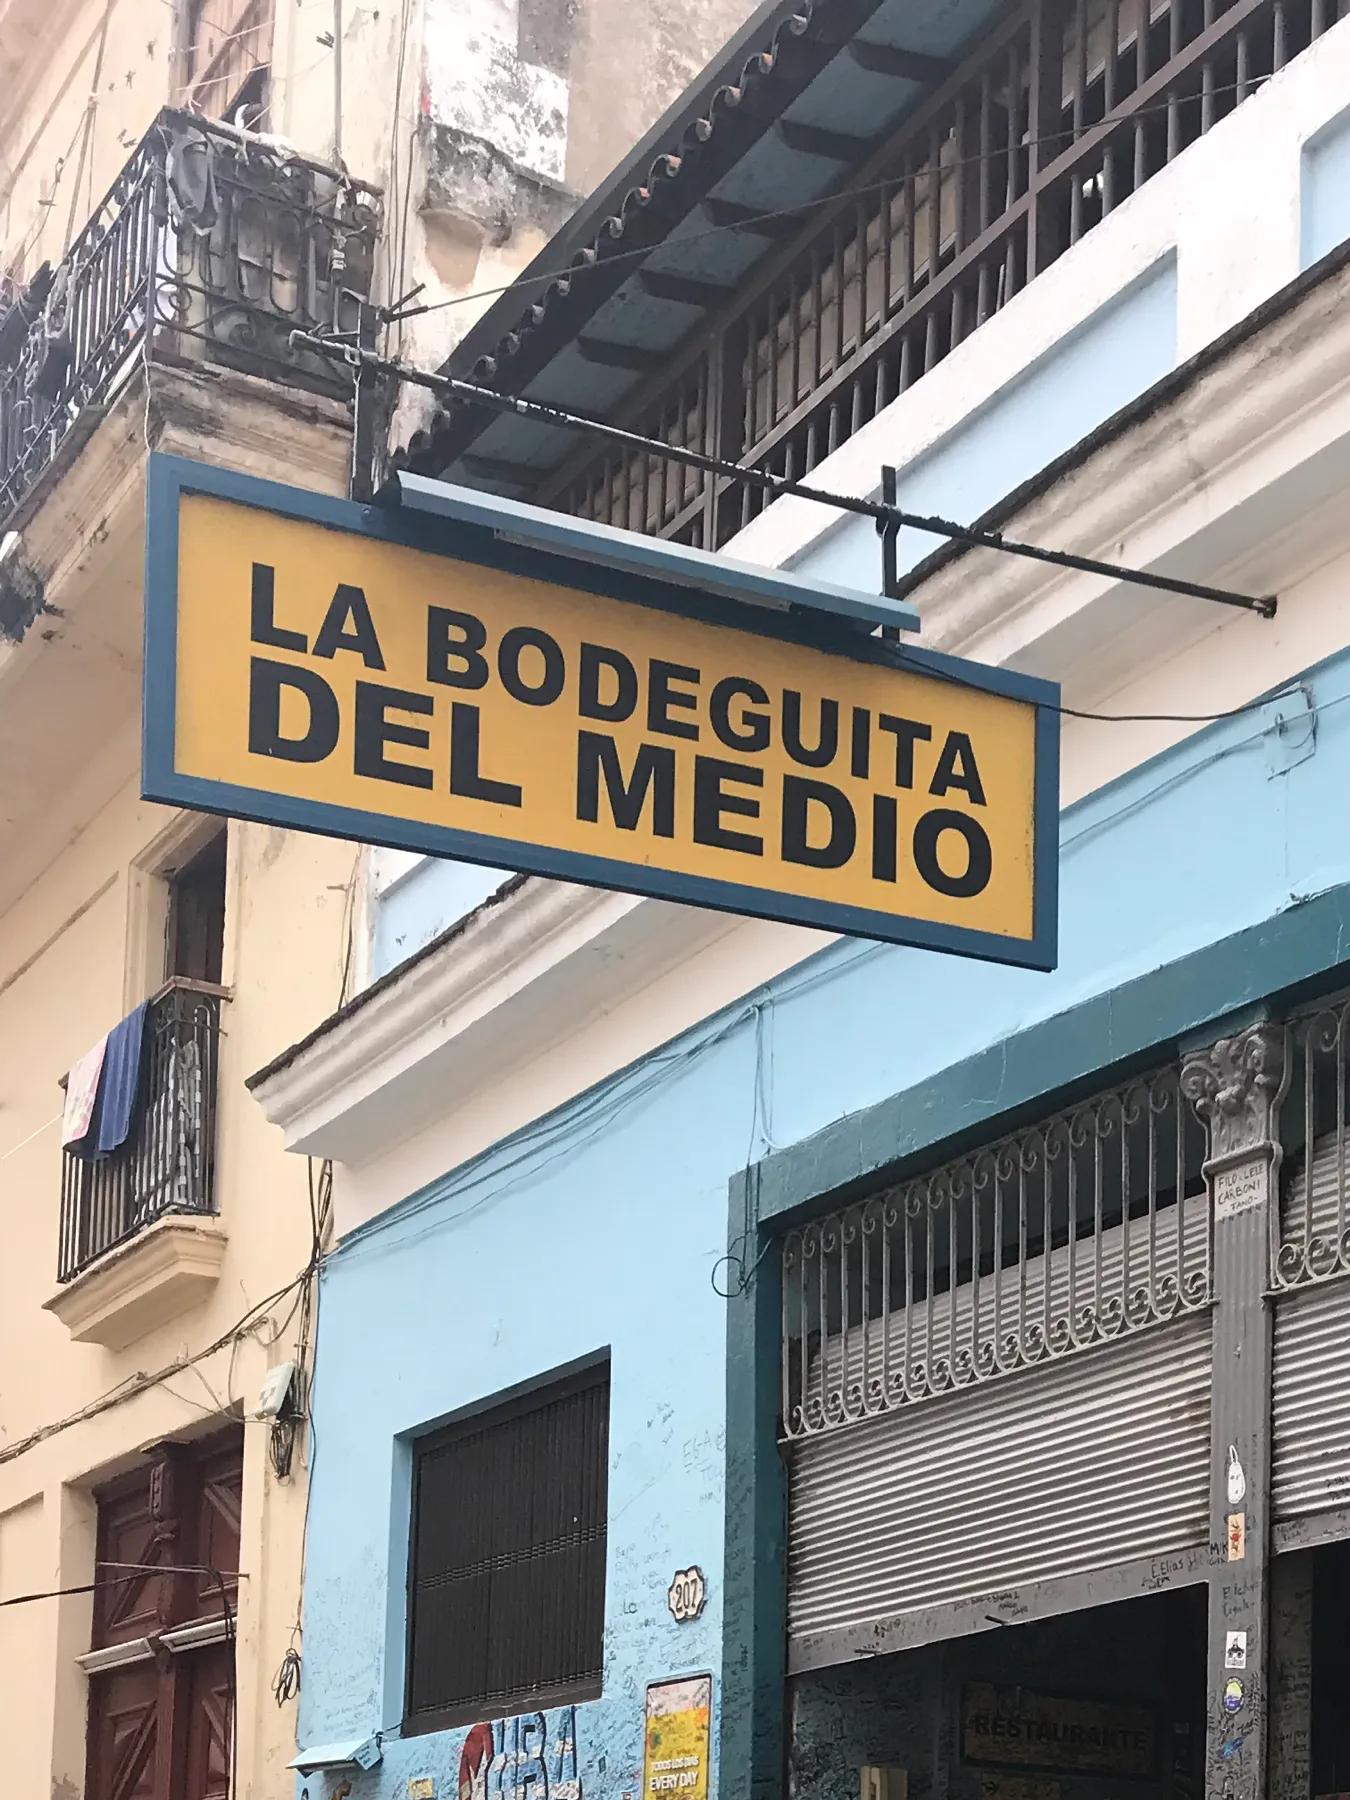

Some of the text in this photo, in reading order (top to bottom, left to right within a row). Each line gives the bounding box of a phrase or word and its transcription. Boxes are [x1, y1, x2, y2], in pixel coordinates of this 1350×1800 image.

[250, 562, 988, 807] LA BODEGUITA
[247, 656, 993, 899] DEL MEDIO
[676, 1577, 700, 1613] 207
[649, 1771, 699, 1791] EVERY DAY
